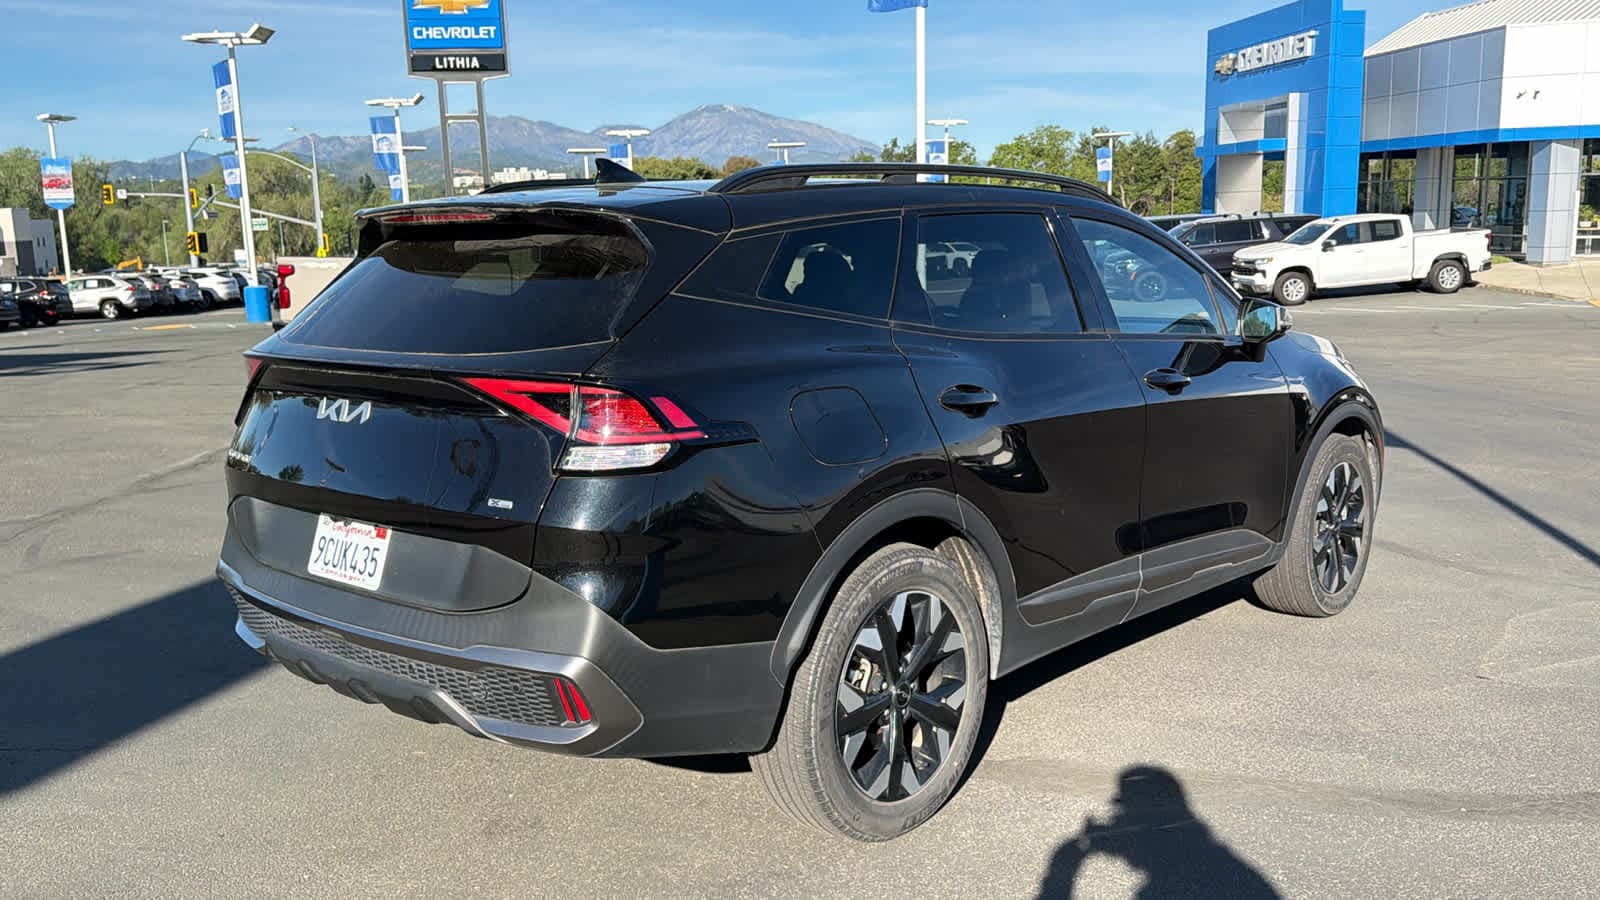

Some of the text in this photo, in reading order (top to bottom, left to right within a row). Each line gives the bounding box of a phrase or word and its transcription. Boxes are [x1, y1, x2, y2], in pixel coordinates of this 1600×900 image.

[412, 26, 497, 39] CHEVROLET
[434, 56, 480, 69] LITHIA
[1237, 30, 1320, 72] CHEVROLET
[316, 396, 372, 424] KIA
[313, 535, 381, 578] 9CUK435
